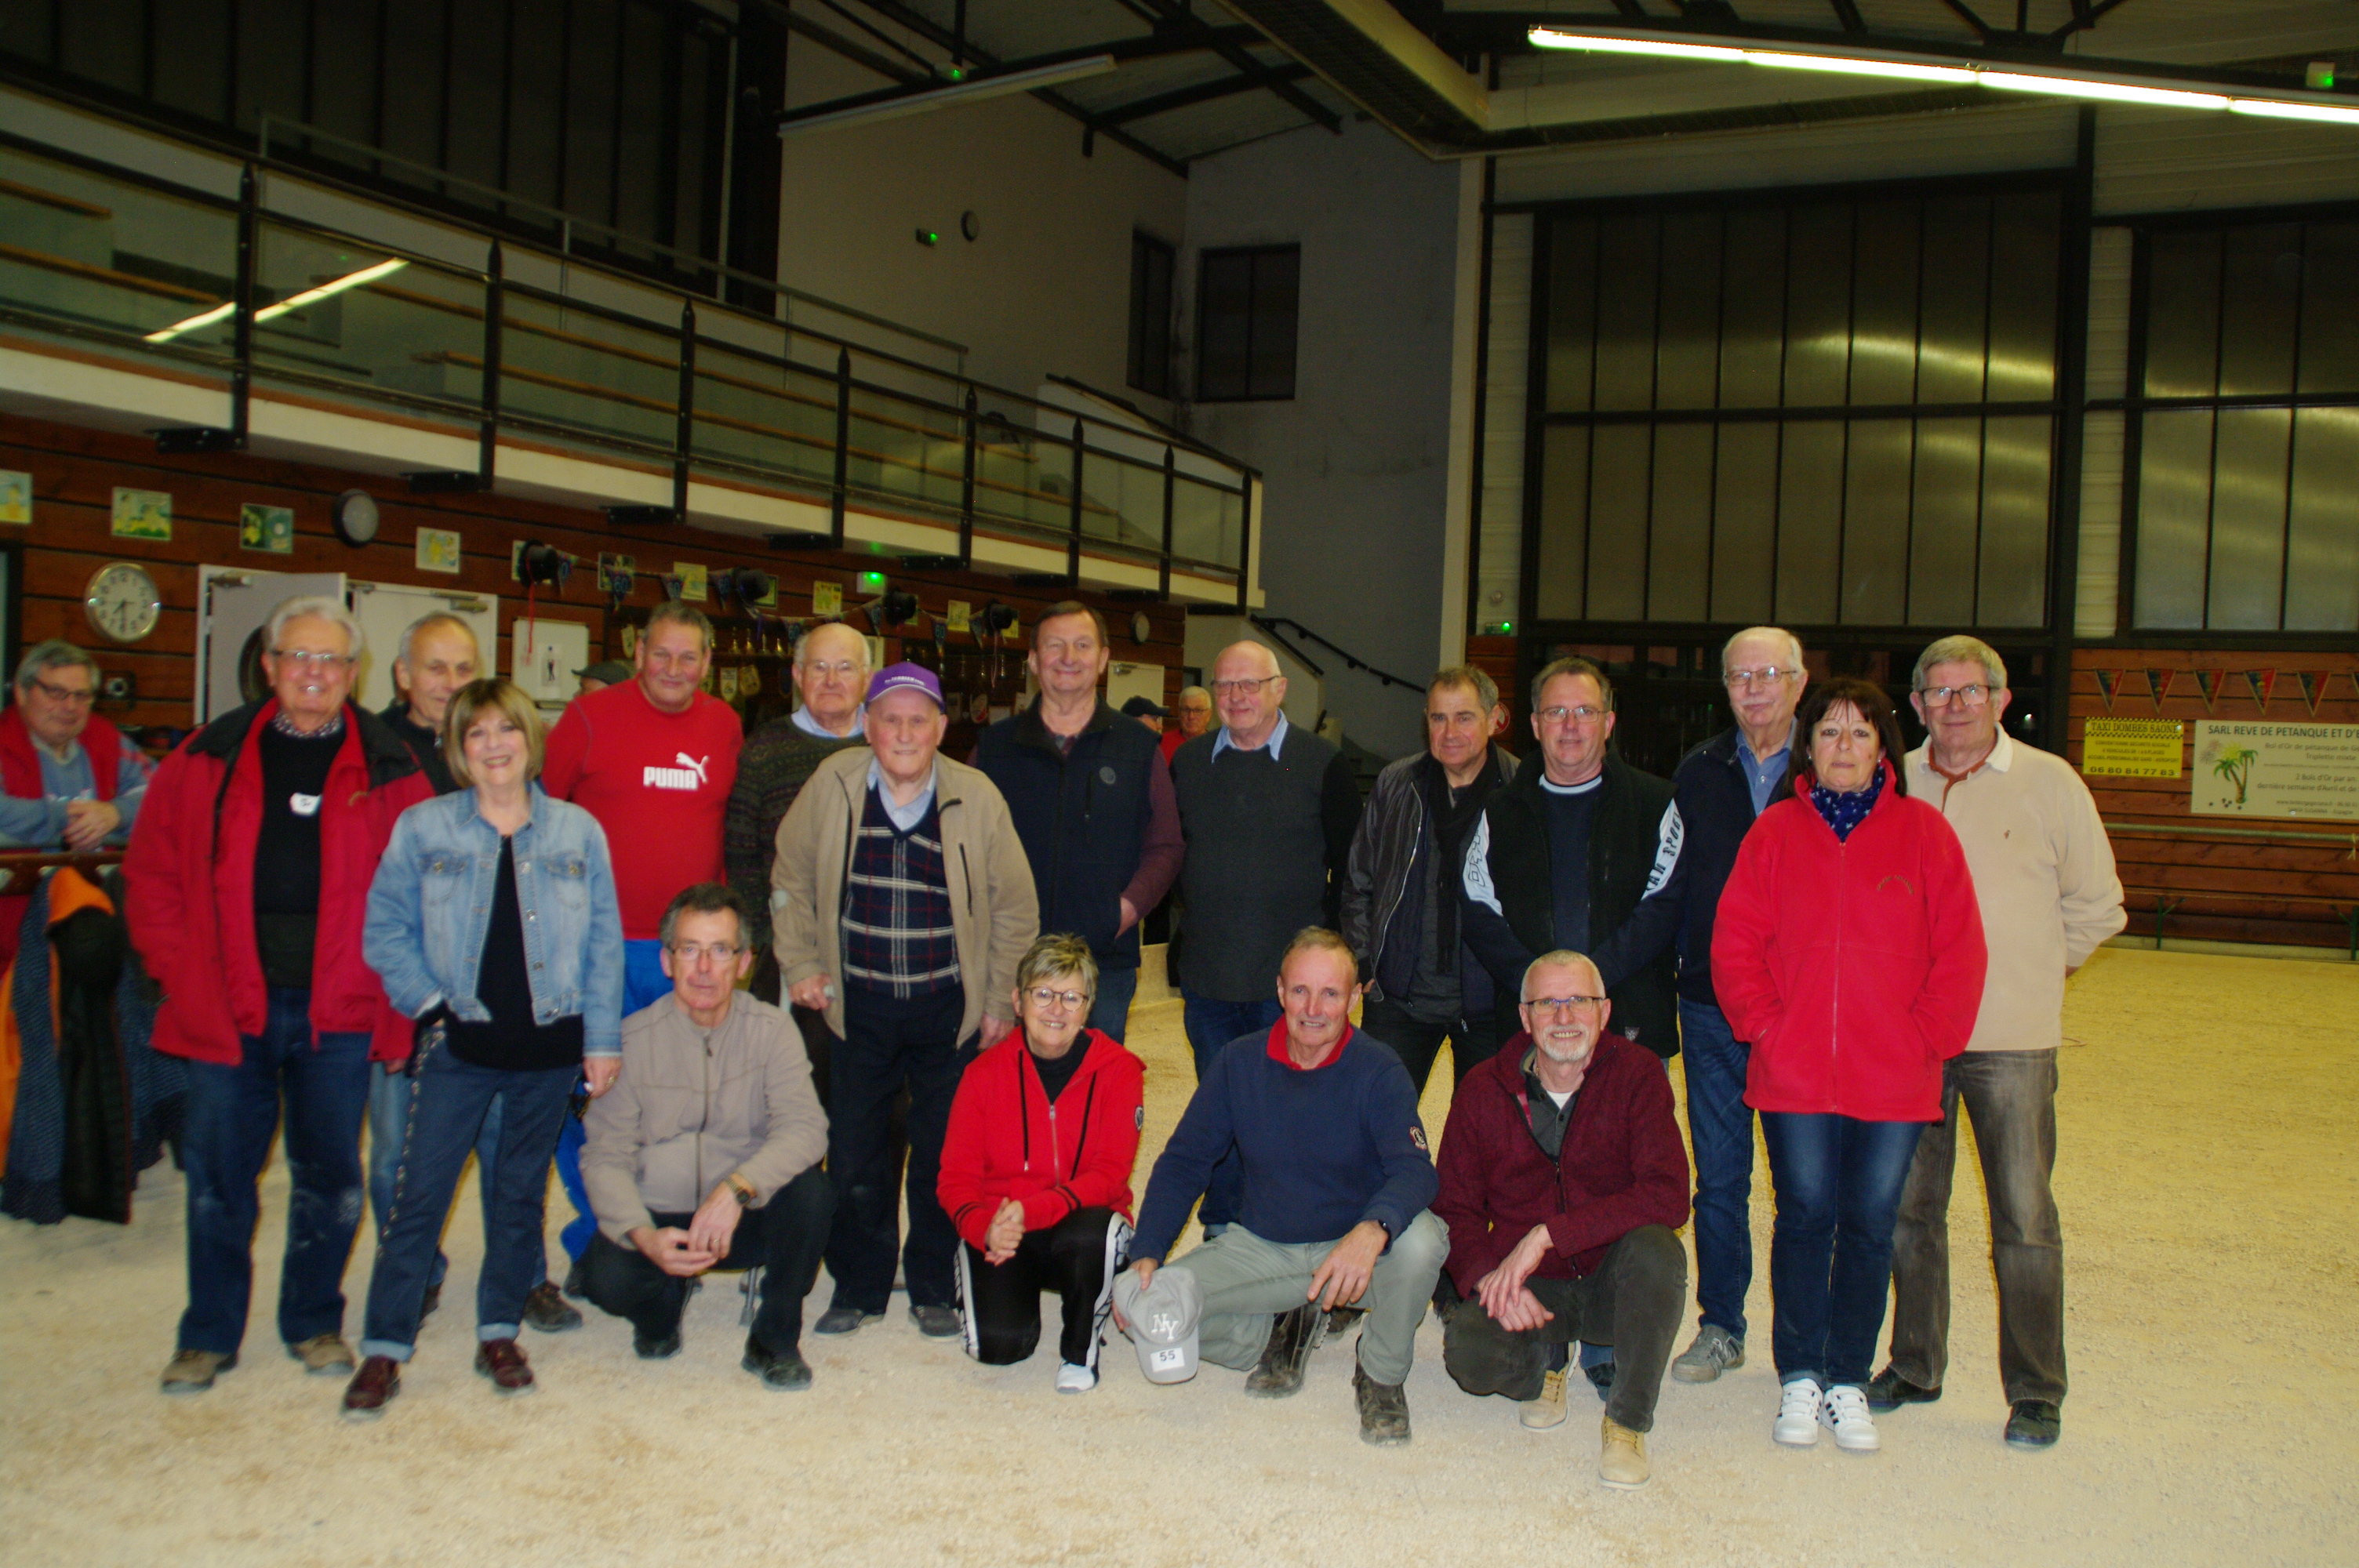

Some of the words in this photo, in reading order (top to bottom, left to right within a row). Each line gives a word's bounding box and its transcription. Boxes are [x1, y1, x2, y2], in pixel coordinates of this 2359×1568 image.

[2092, 722, 2111, 731] TAXI
[2114, 723, 2148, 732] DOMBES
[2208, 724, 2231, 735] SARL
[2261, 726, 2274, 736] DE
[2276, 727, 2328, 739] PETANQUE
[2331, 728, 2343, 738] ET
[643, 766, 697, 791] PUMA
[1150, 1312, 1180, 1341] NY
[1159, 1349, 1176, 1363] 55
